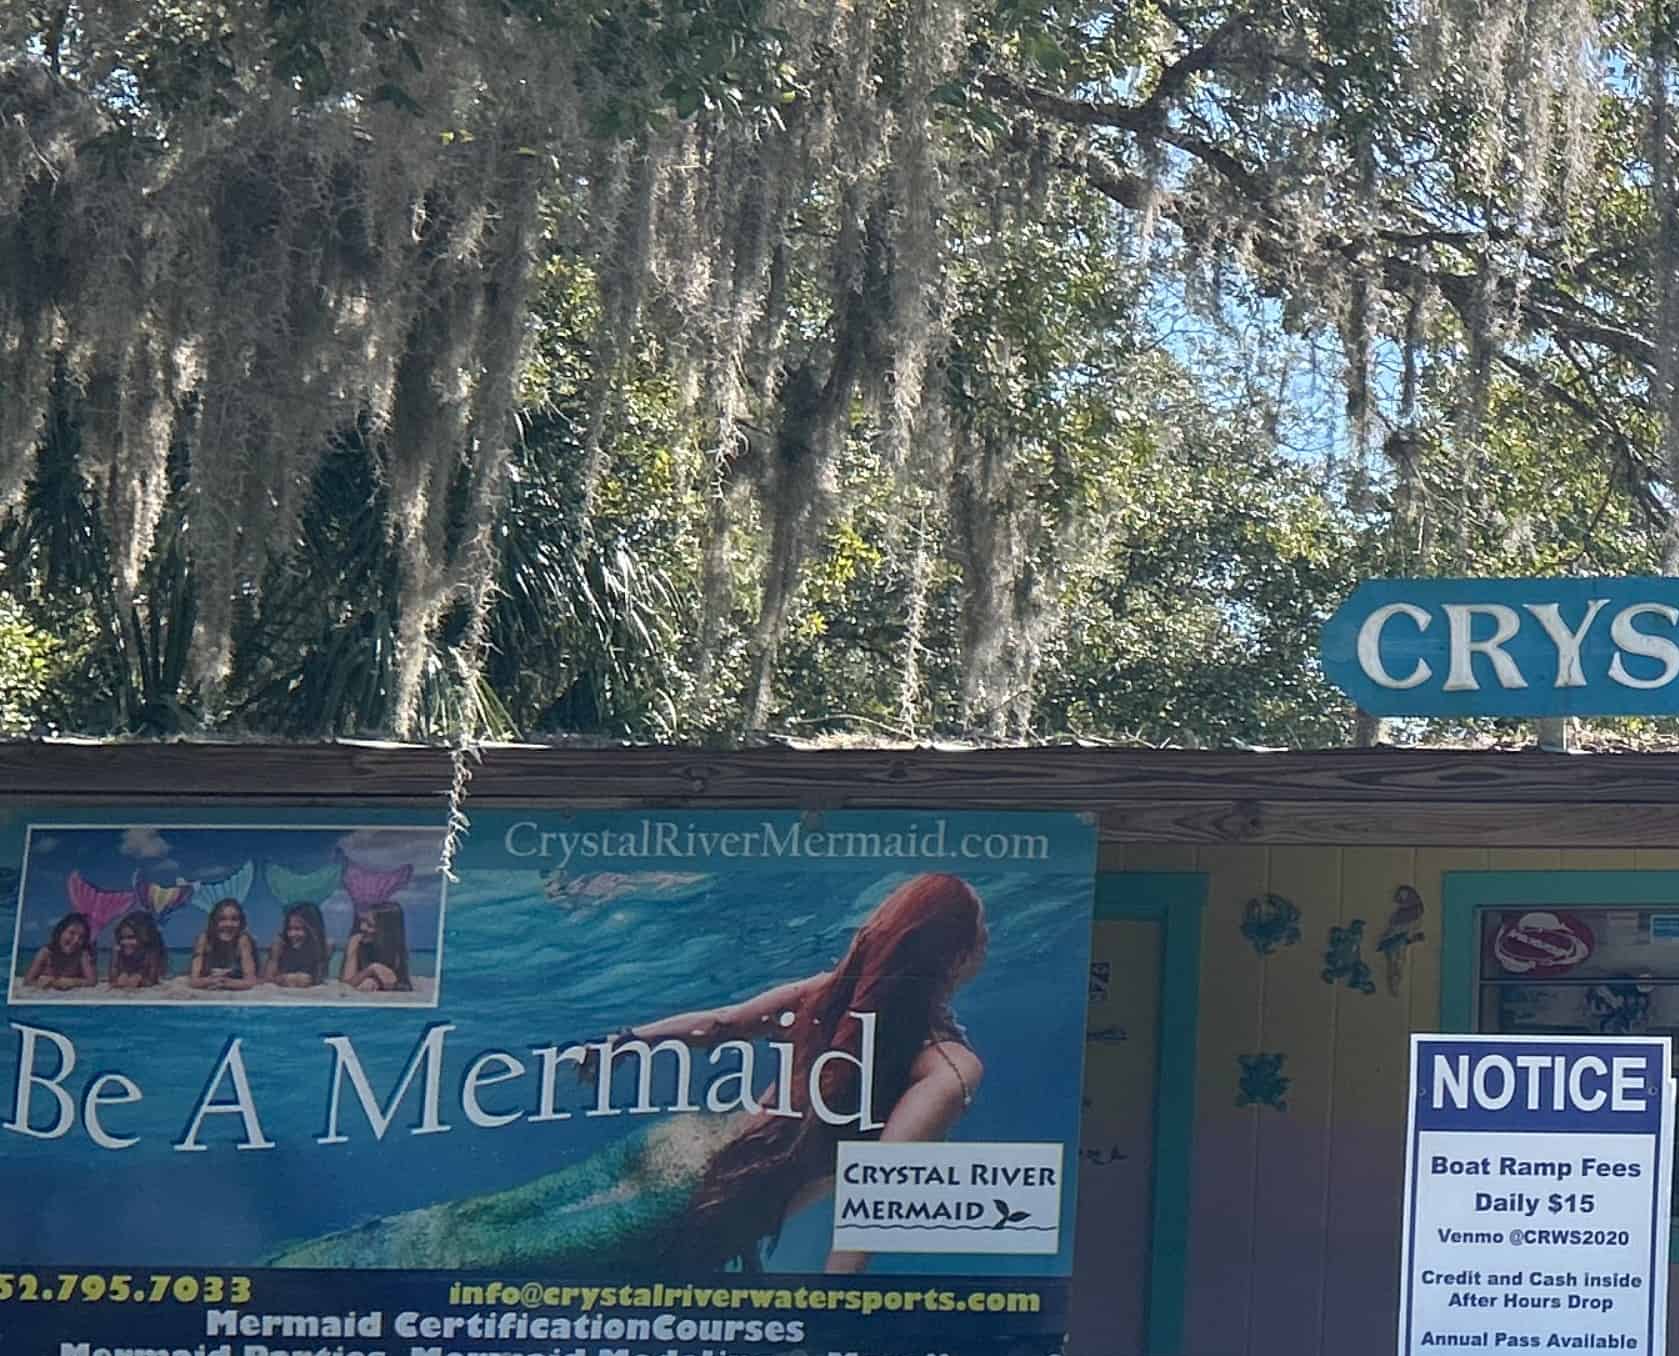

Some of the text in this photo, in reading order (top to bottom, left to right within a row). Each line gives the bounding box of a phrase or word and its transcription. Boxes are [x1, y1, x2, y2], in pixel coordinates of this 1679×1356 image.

[503, 820, 1050, 868] CrystalRiverMermaid.com
[3, 1009, 886, 1152] Be A Mermaid
[1431, 1054, 1648, 1112] NOTICE
[843, 1162, 1057, 1187] CRYSTAL RIVER
[1430, 1156, 1642, 1181] Boat Ramp Fees
[841, 1197, 985, 1221] MERMAID
[1475, 1192, 1595, 1217] Daily $15
[1437, 1228, 1630, 1247] Venmo @CRWS2020
[1421, 1270, 1643, 1289] Credit and Cash inside
[449, 1281, 1040, 1315] info@crystalriverwatersports.com
[1448, 1293, 1614, 1313] After Hours Drop
[205, 1309, 383, 1339] Mermaid
[1420, 1331, 1638, 1350] Annual Pass Available
